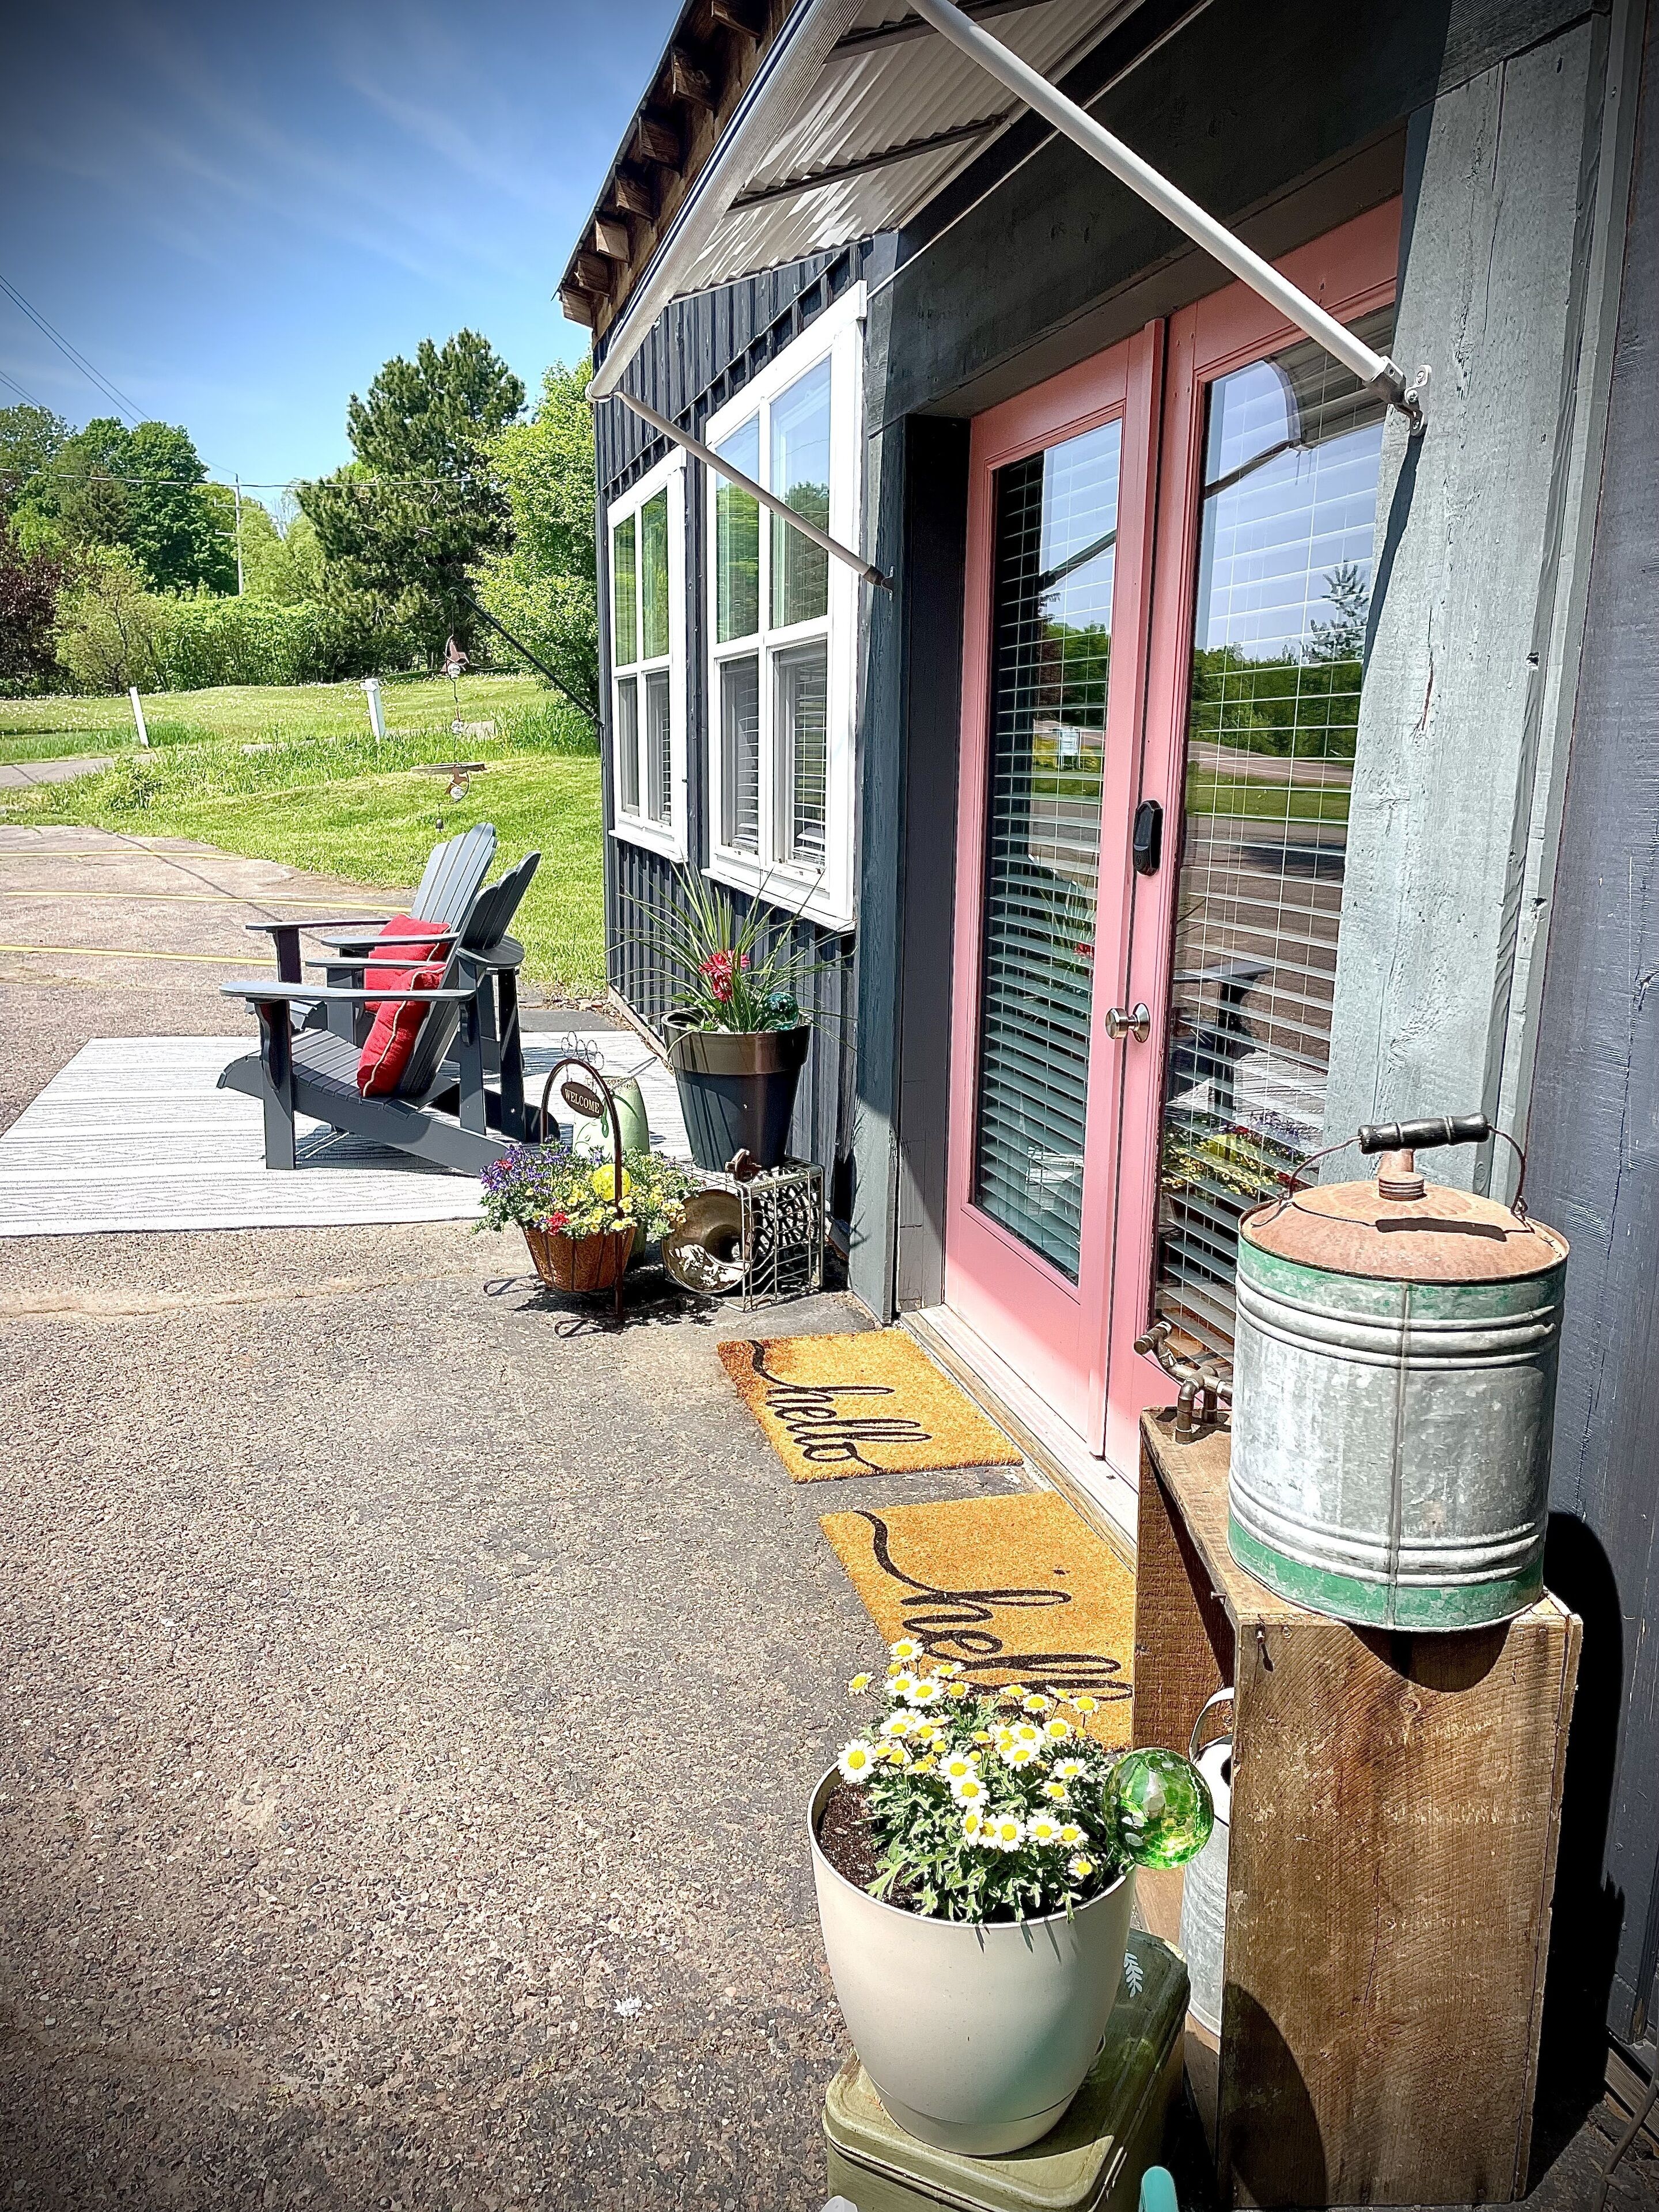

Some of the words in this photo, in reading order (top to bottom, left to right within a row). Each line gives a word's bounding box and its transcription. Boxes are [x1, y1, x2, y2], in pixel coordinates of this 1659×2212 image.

[565, 1088, 600, 1113] WELCOME
[747, 1339, 933, 1472] hello
[853, 1510, 1133, 1728] hell
